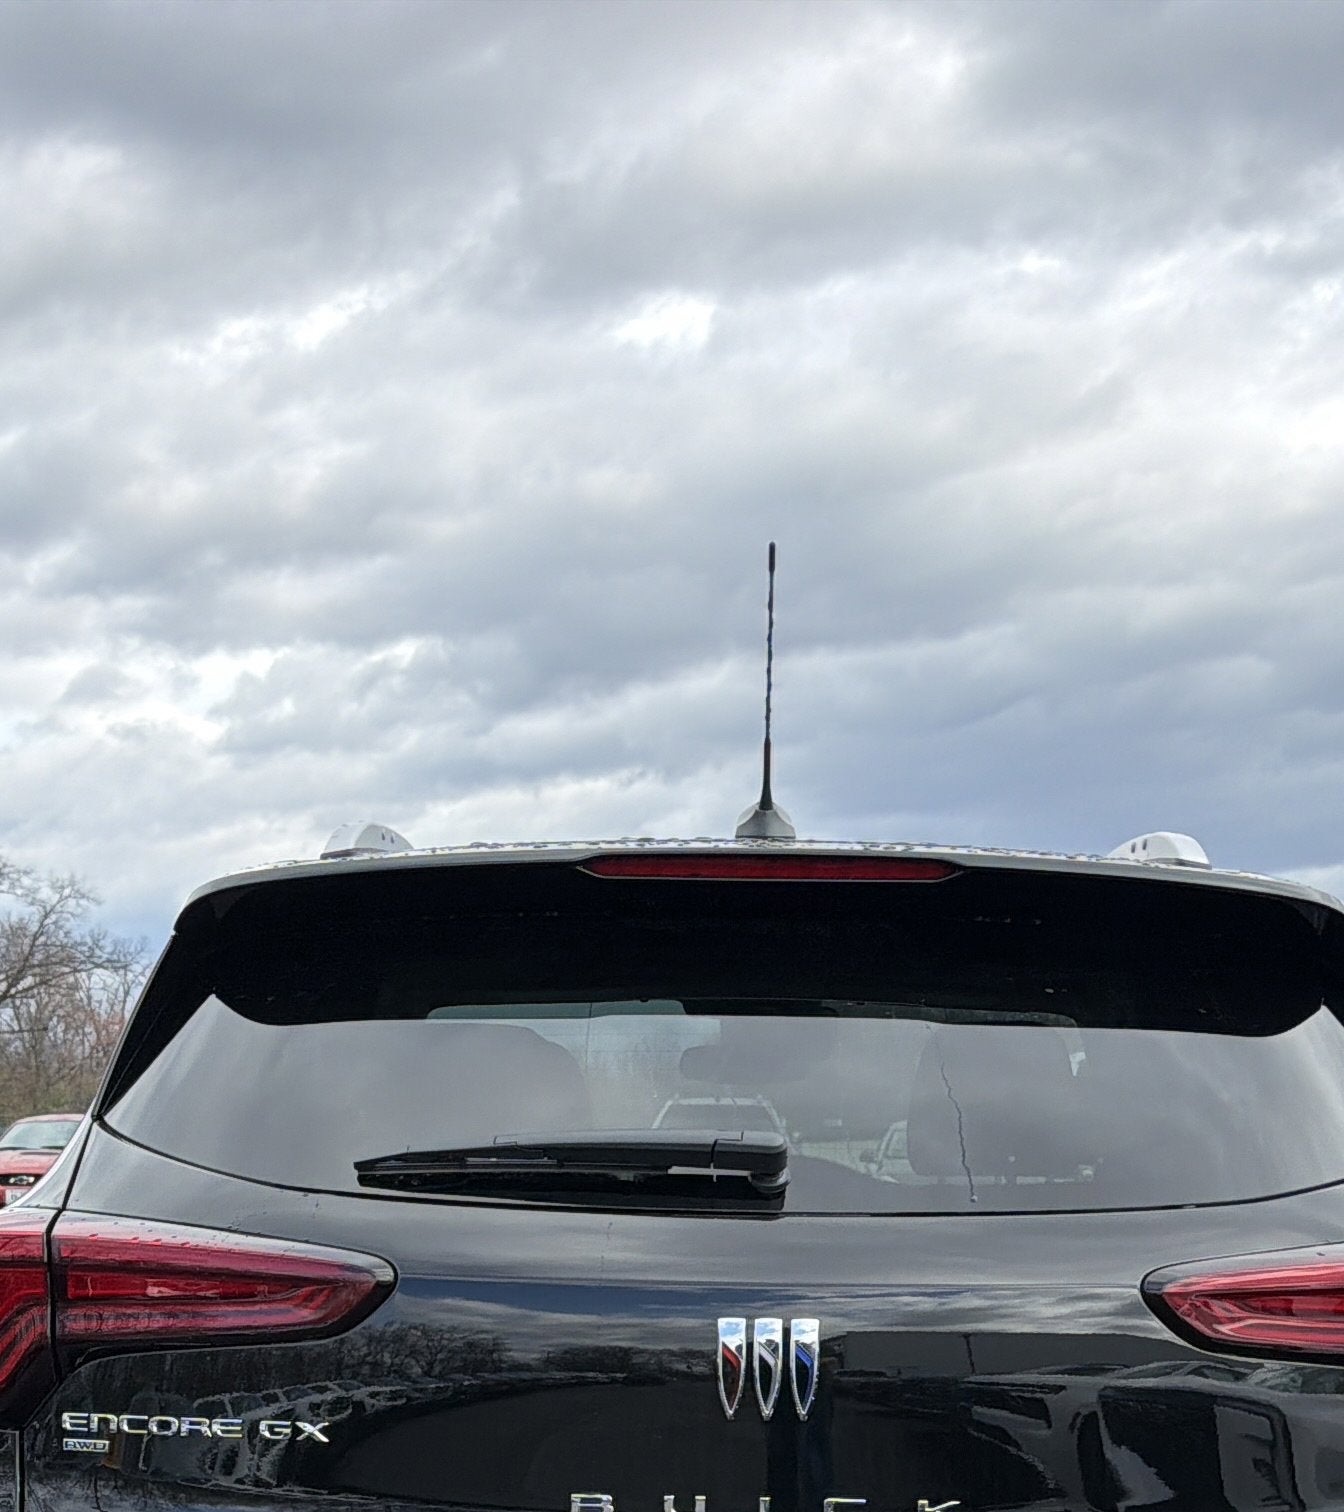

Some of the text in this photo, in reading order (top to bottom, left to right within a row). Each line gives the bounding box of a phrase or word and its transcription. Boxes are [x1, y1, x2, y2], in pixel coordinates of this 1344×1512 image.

[61, 1411, 330, 1444] ENCORE GX
[64, 1439, 107, 1451] AWD
